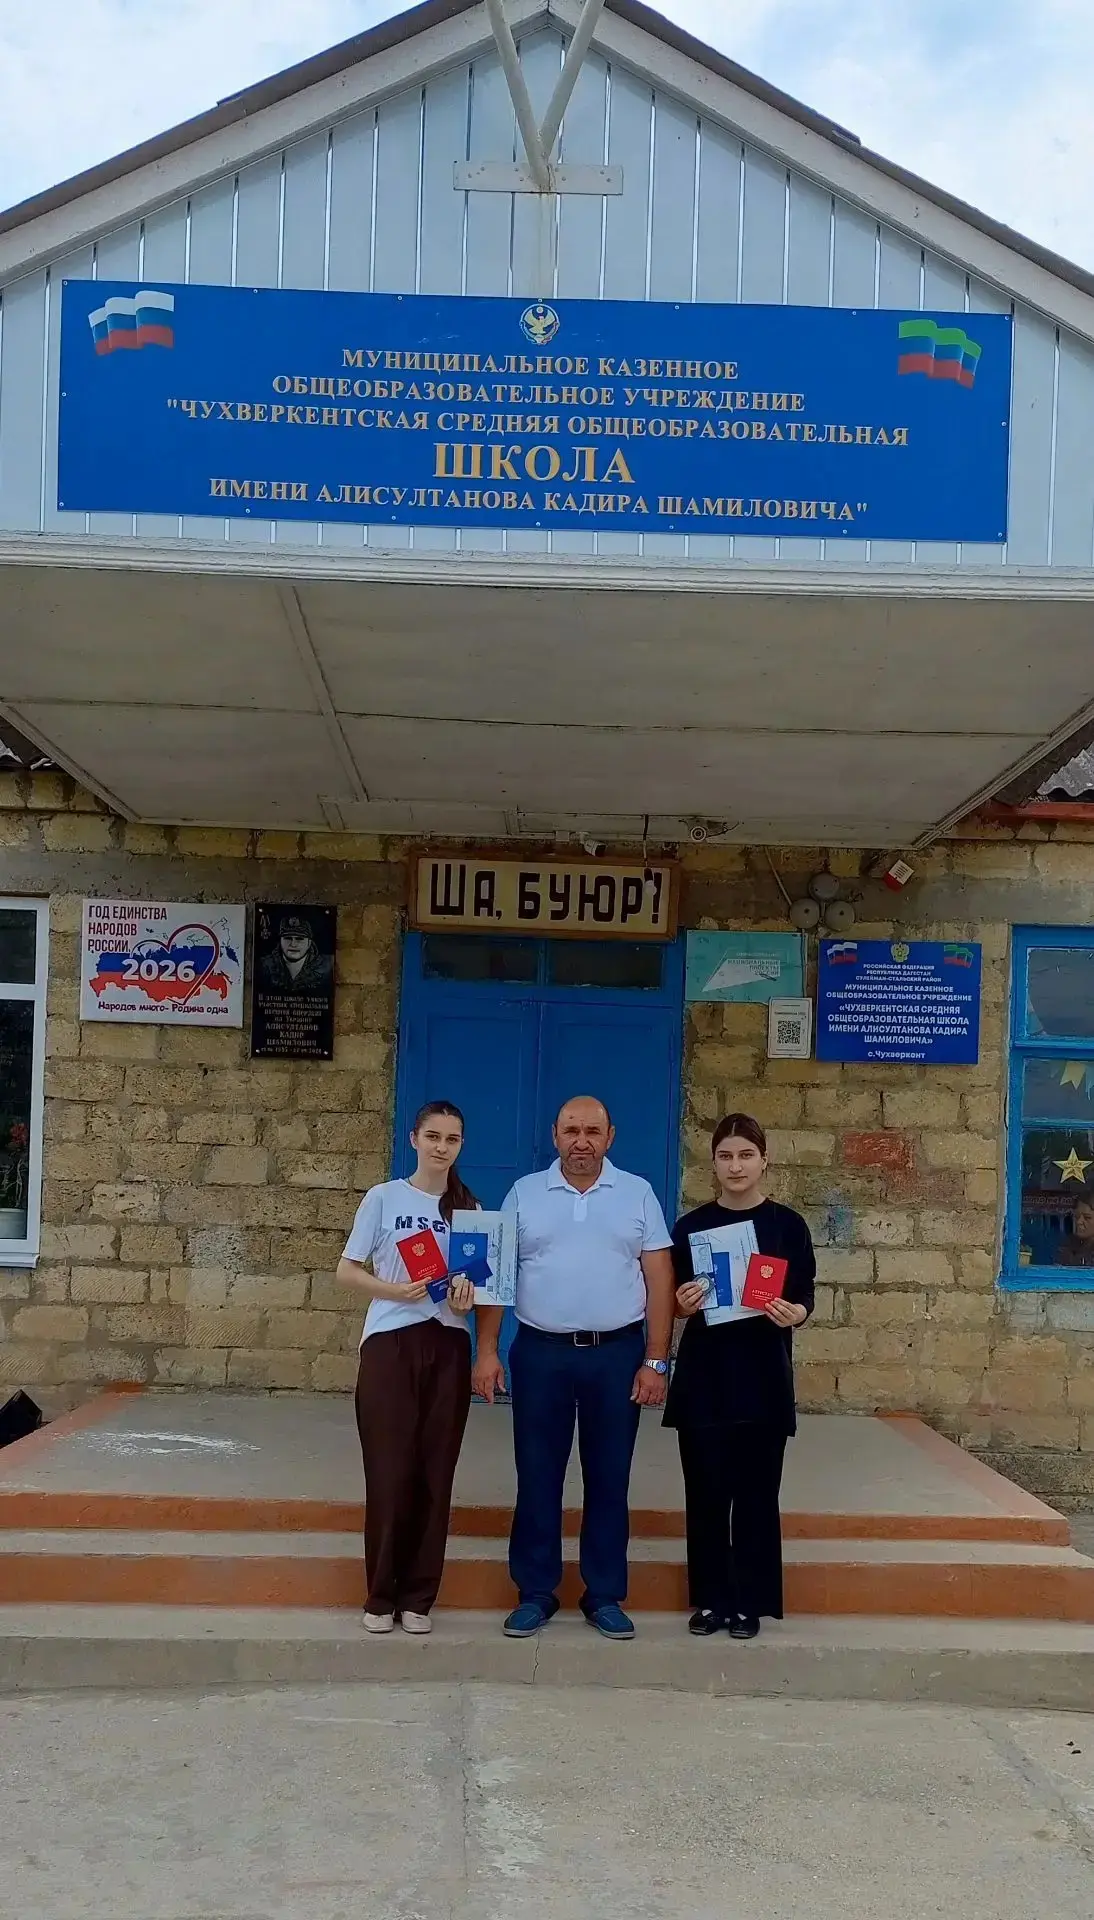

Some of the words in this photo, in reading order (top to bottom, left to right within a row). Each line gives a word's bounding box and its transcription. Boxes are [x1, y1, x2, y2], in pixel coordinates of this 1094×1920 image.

[341, 349, 589, 375] МУНИЦИПАЛЬНОЕ
[597, 357, 738, 380] КАЗЕННОЕ
[272, 375, 615, 406] ОБЩЕОБРАЗОВАТЕЛЬНОЕ
[624, 388, 805, 413] УЧРЕЖДЕНИЕ
[166, 398, 429, 431] "ЧУХВЕРКЕНТСКАЯ
[437, 412, 560, 434] СРЕДНЯЯ
[567, 416, 909, 446] ОБЩЕОБРАЗОВАТЕЛЬНАЯ
[432, 442, 635, 484] ШКОЛА
[209, 477, 308, 502] ИМЕНИ
[316, 483, 535, 510] АЛИСУЛТАНОВА
[544, 492, 650, 515] КАДИРА
[657, 496, 868, 522] ШАМИЛОВИЧА"
[430, 863, 503, 920] ША,
[518, 871, 662, 924] БУЮР!
[88, 905, 110, 920] ГОД
[113, 906, 168, 920] ЕДИНСТВА
[88, 922, 137, 937] НАРОДОВ
[121, 957, 196, 982] 2026
[845, 984, 913, 992] МУНИЦИПАЛЬНОЕ
[914, 985, 954, 993] КАЗЕННОЕ
[826, 992, 921, 1001] ОБЩЕОБРАЗОВАТЕЛЬНОЕ
[922, 993, 972, 1001] УЧРЕЖДЕНИЕ
[98, 1001, 136, 1012] Народов
[172, 1004, 204, 1014] Родина
[206, 1006, 228, 1015] одна
[839, 1004, 920, 1013] «ЧУХВЕРКЕНТСКАЯ
[921, 1005, 960, 1015] СРЕДНЯЯ
[827, 1014, 936, 1024] ОБЩЕОБРАЗОВАТЕЛЬНАЯ
[937, 1017, 969, 1025] ШКОЛА
[860, 1025, 931, 1034] АЛИСУЛТАНОВА
[932, 1027, 968, 1036] КАДИРА
[864, 1035, 933, 1045] ШАМИЛОВИЧА»
